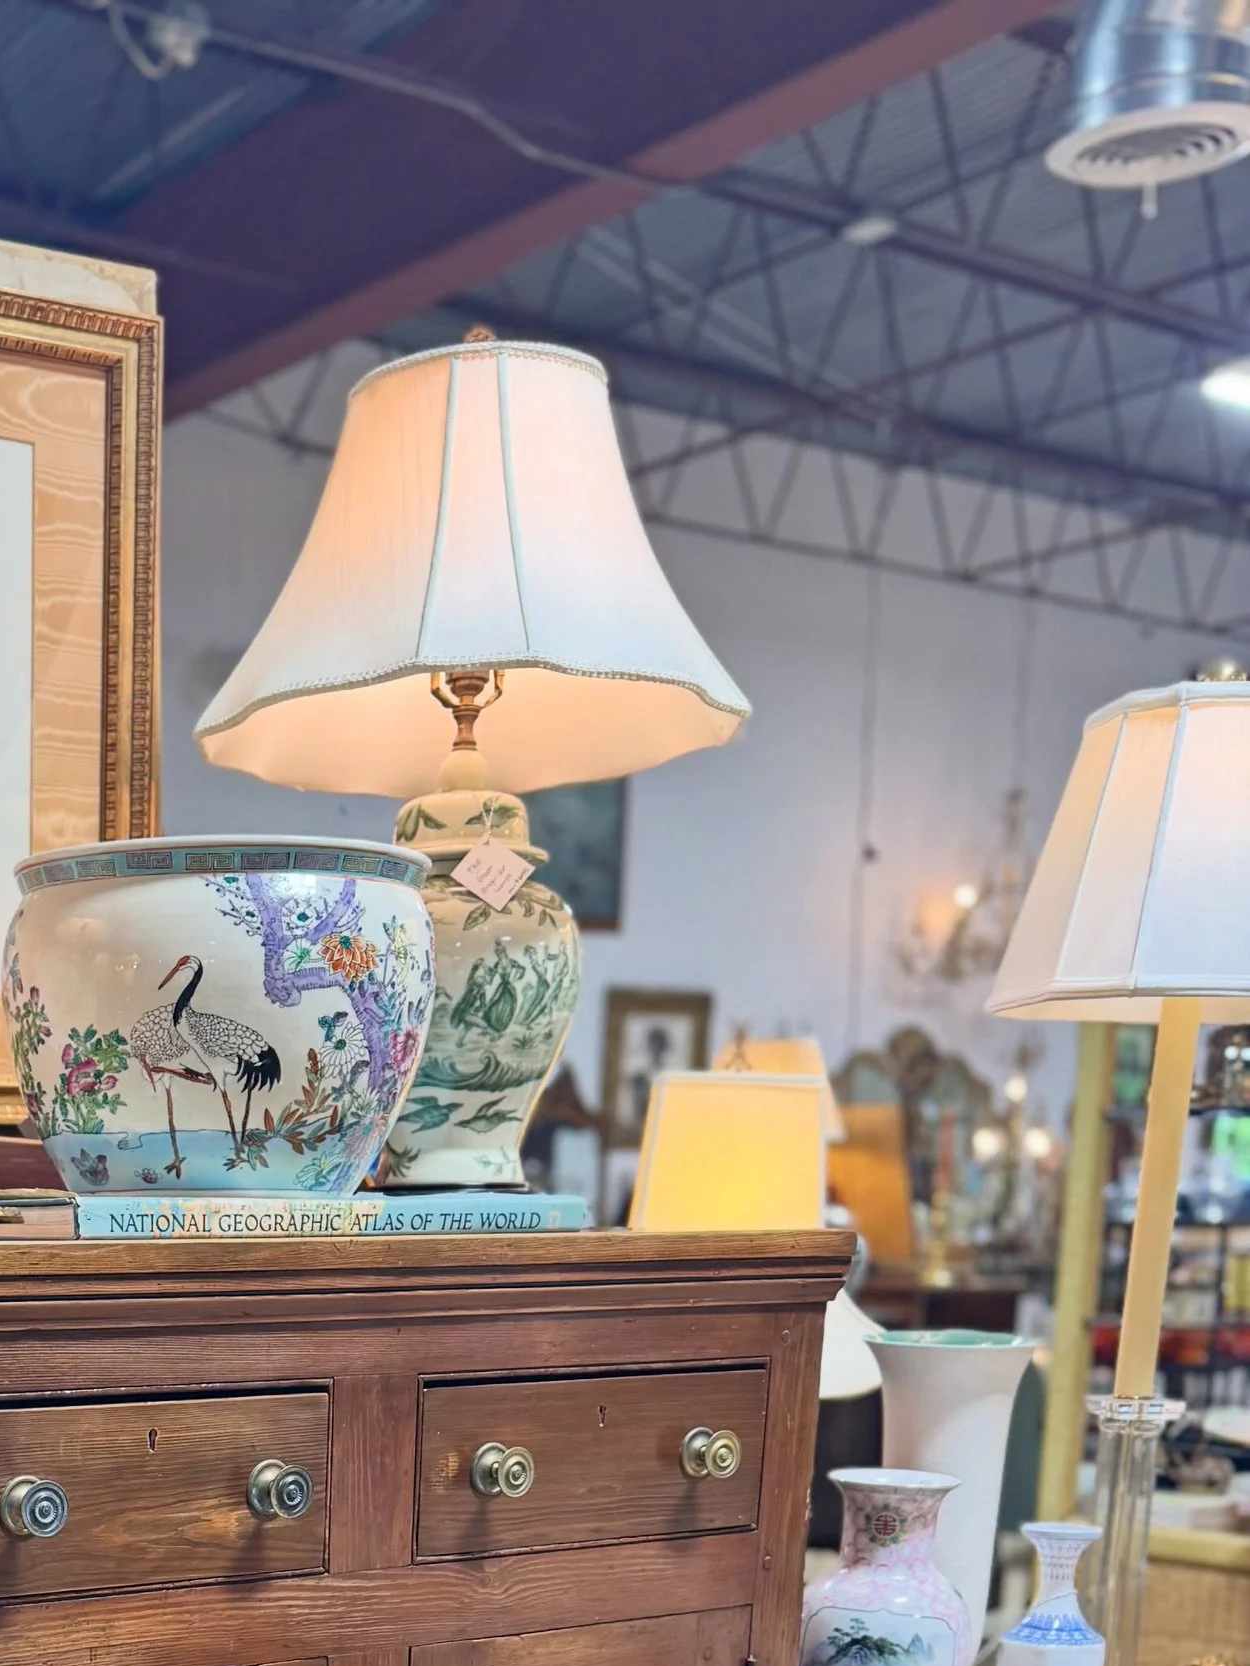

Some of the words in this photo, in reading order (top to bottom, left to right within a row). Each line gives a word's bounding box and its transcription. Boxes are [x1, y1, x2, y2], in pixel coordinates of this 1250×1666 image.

[109, 1213, 212, 1233] NATIONAL
[218, 1213, 343, 1233] GEOGRAPHIC
[350, 1212, 405, 1231] ATLAS
[410, 1212, 434, 1231] OF
[440, 1212, 475, 1230] THE
[480, 1211, 542, 1230] WORLD
